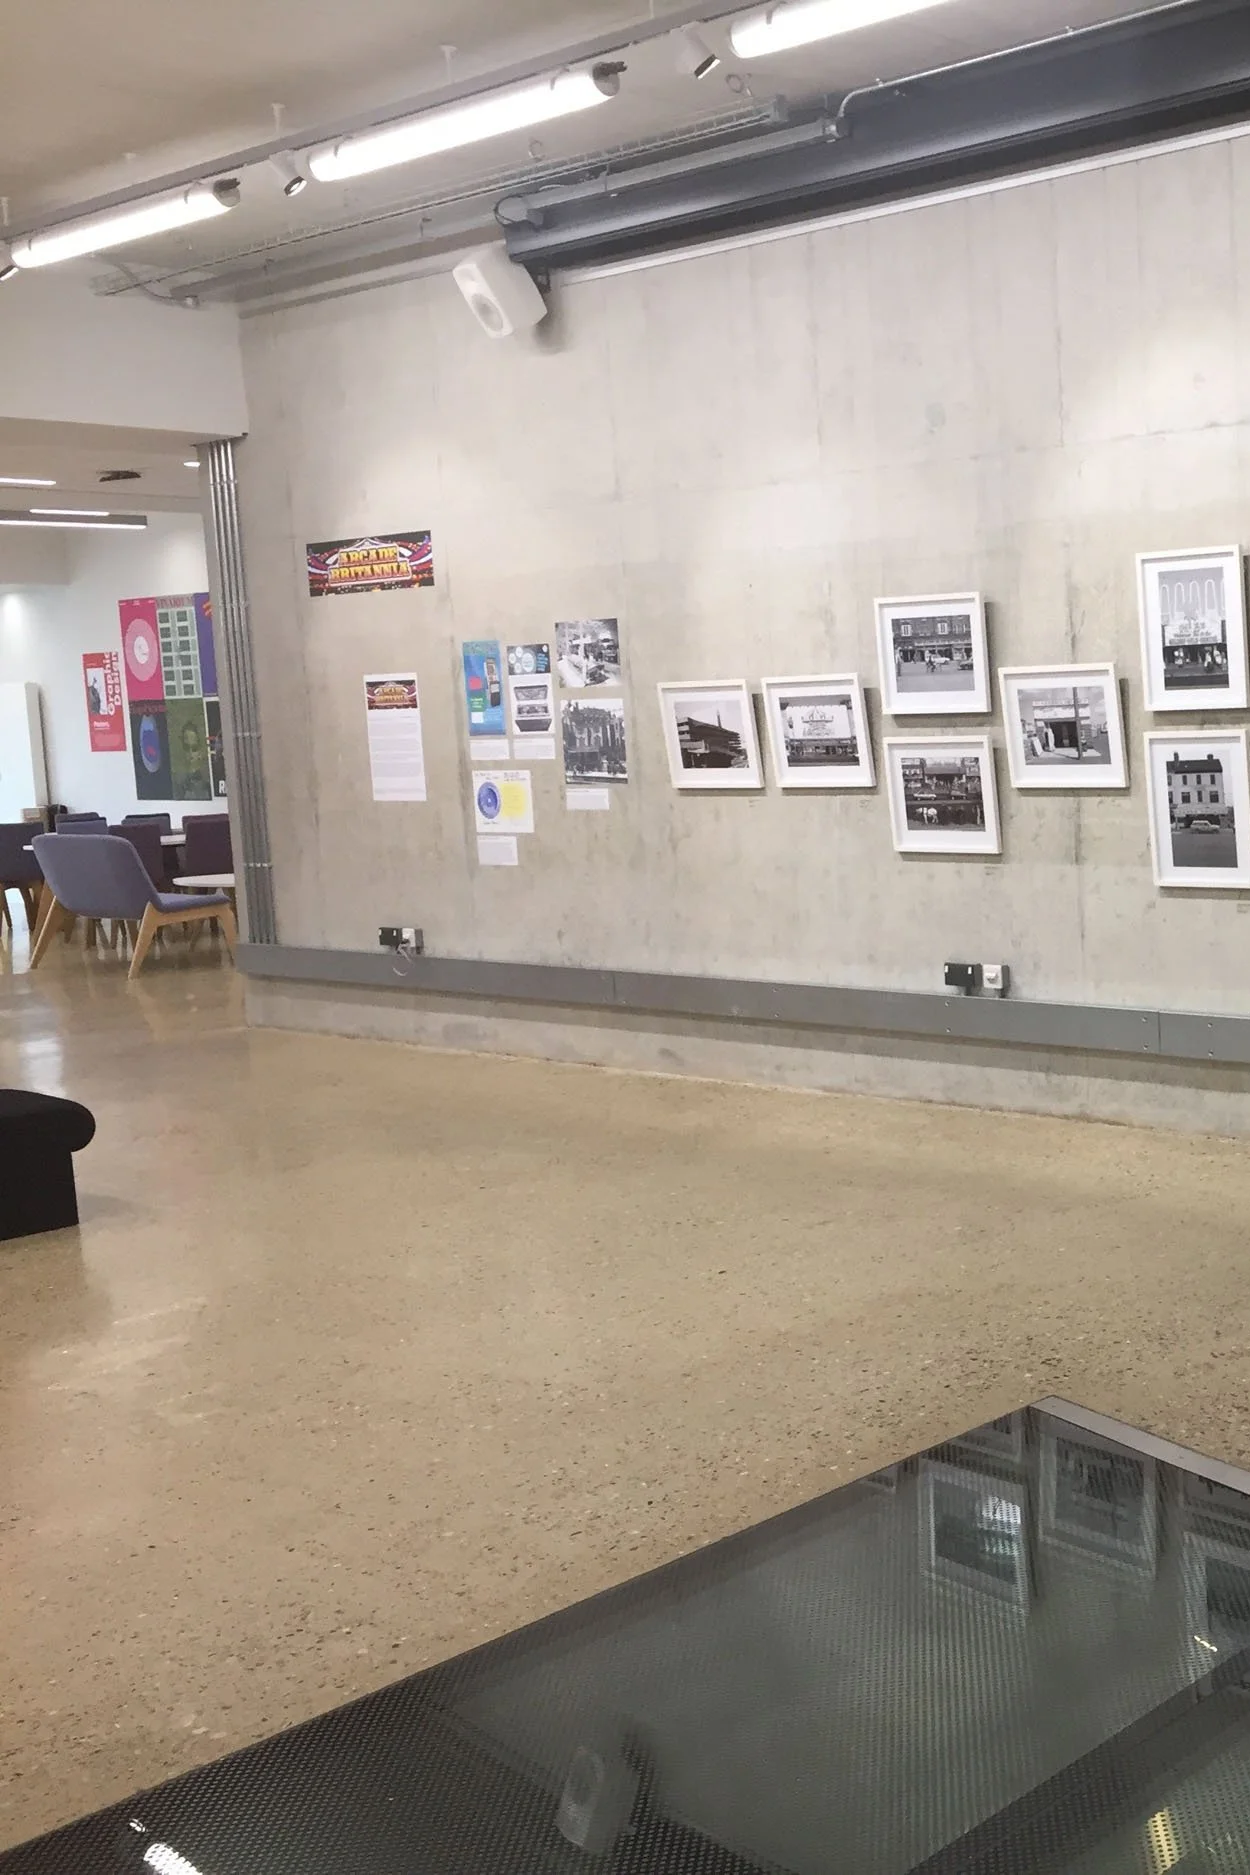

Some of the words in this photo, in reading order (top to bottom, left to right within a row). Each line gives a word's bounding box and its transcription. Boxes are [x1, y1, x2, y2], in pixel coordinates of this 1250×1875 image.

[331, 562, 408, 581] BRITANNIA
[340, 547, 397, 564] ARCADE
[103, 652, 115, 715] Graphic
[112, 652, 121, 706] Design
